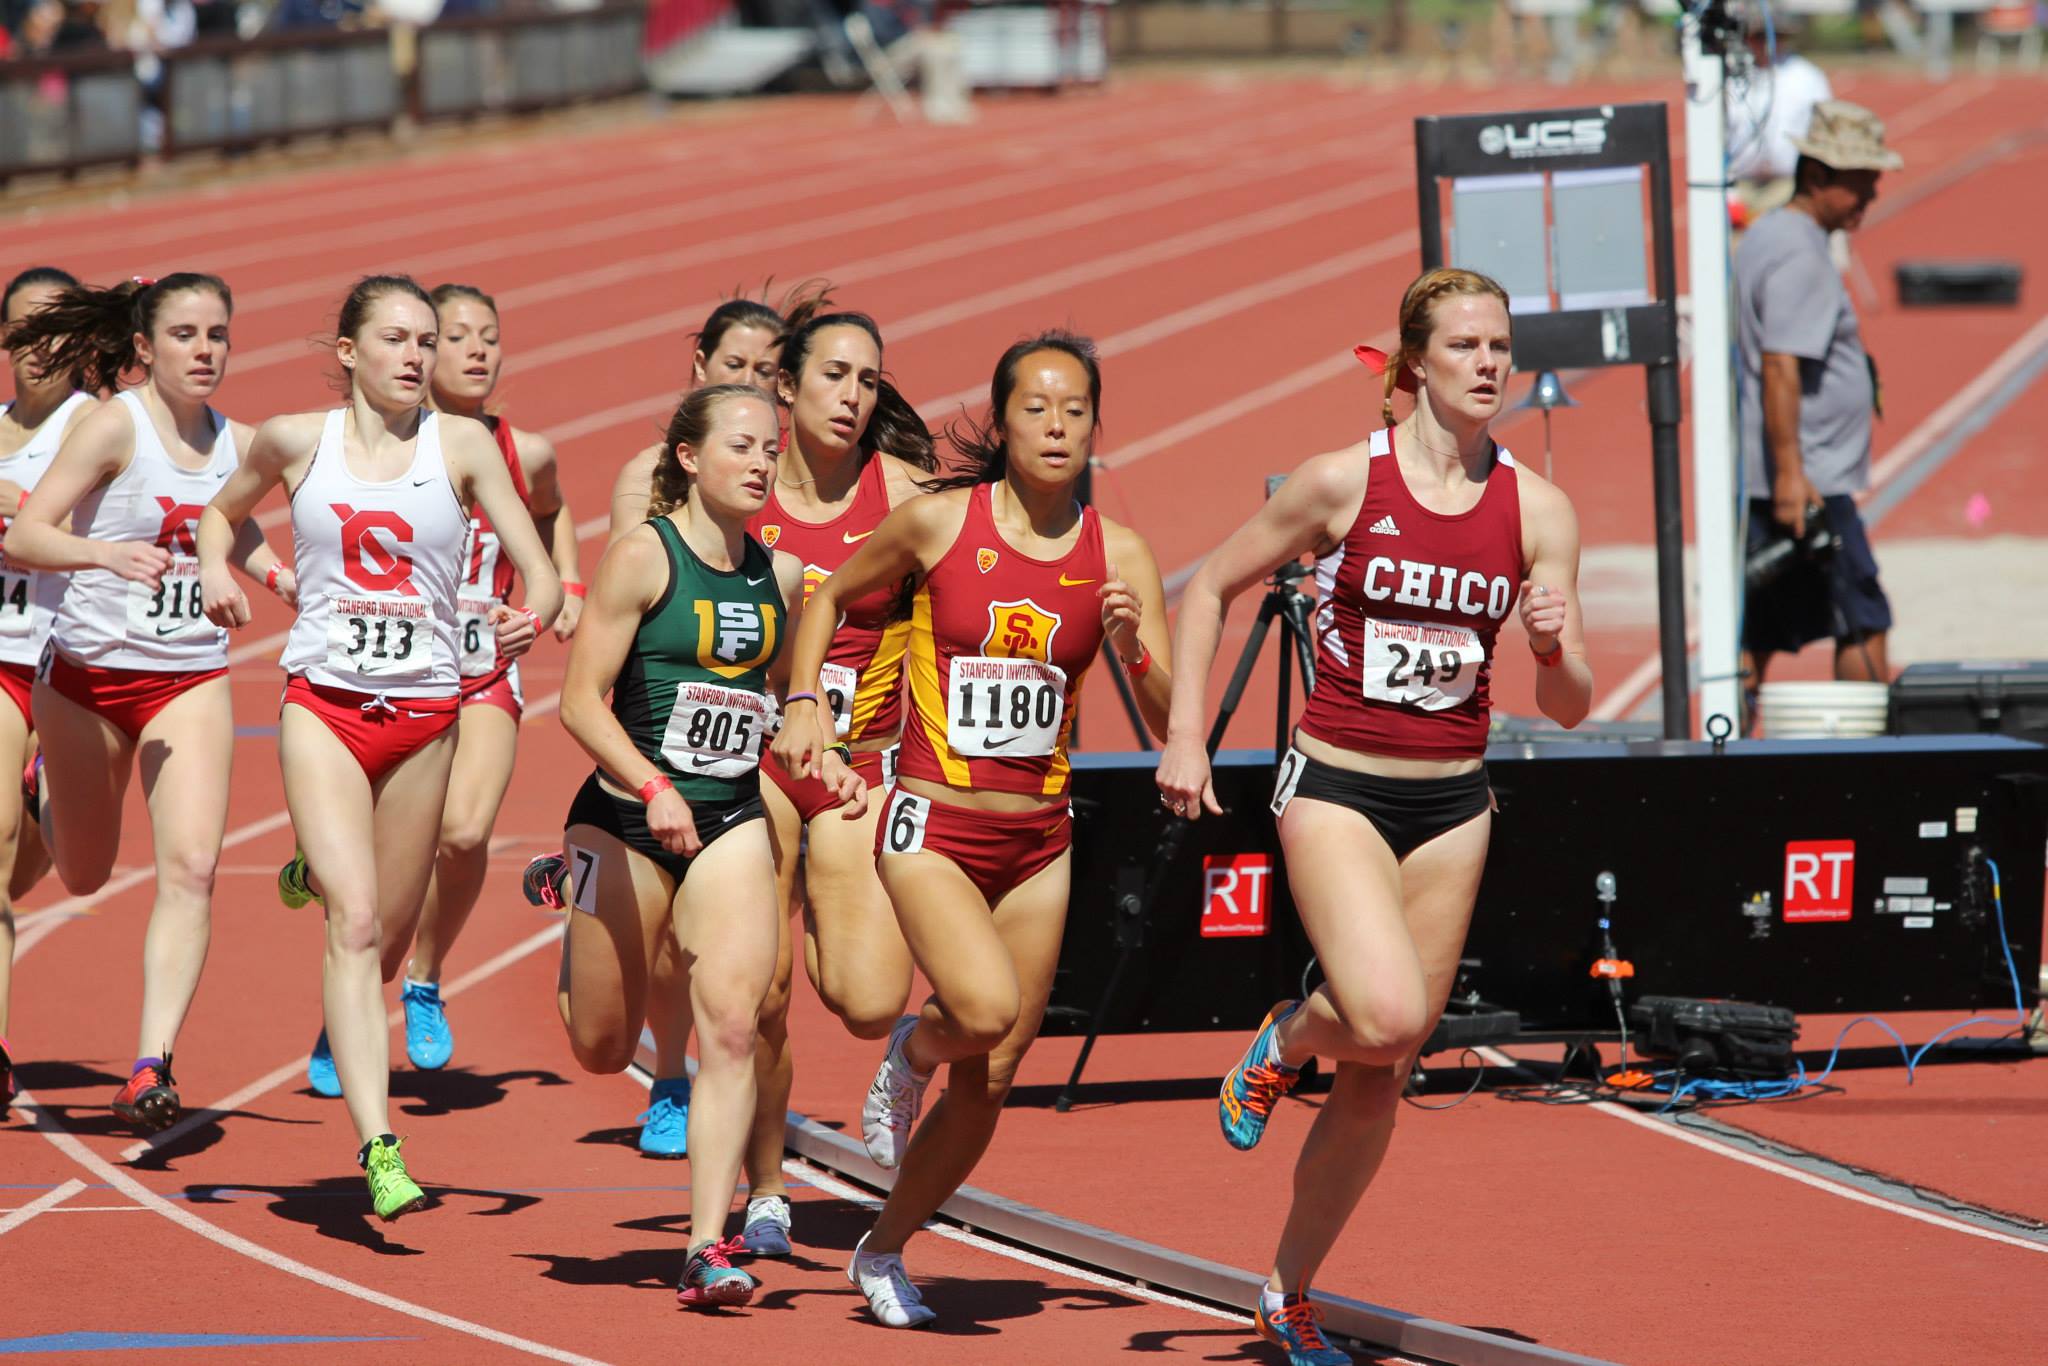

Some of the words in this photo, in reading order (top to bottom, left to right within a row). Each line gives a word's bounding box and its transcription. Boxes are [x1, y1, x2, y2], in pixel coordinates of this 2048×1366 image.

[1503, 119, 1607, 149] UCS
[1368, 525, 1401, 537] adidas
[146, 579, 204, 620] 318
[336, 599, 377, 617] STANFORD
[378, 601, 428, 619] INVITATIONAL
[1363, 556, 1511, 620] CHICO
[346, 617, 415, 661] 313
[1374, 622, 1418, 642] STANFORD
[1420, 626, 1471, 648] INVITATIONAL
[960, 662, 1004, 680] STANFORD
[1005, 663, 1059, 682] INVITATIONAL
[1386, 643, 1463, 689] 249
[686, 685, 725, 707] STANFORD
[725, 693, 766, 714] INVITATIONAL
[958, 682, 1057, 730] 1180
[686, 708, 754, 756] 805
[1273, 753, 1297, 812] 2
[890, 796, 918, 852] 6
[574, 850, 594, 905] 7
[1203, 866, 1273, 915] RT
[1786, 852, 1854, 901] RT
